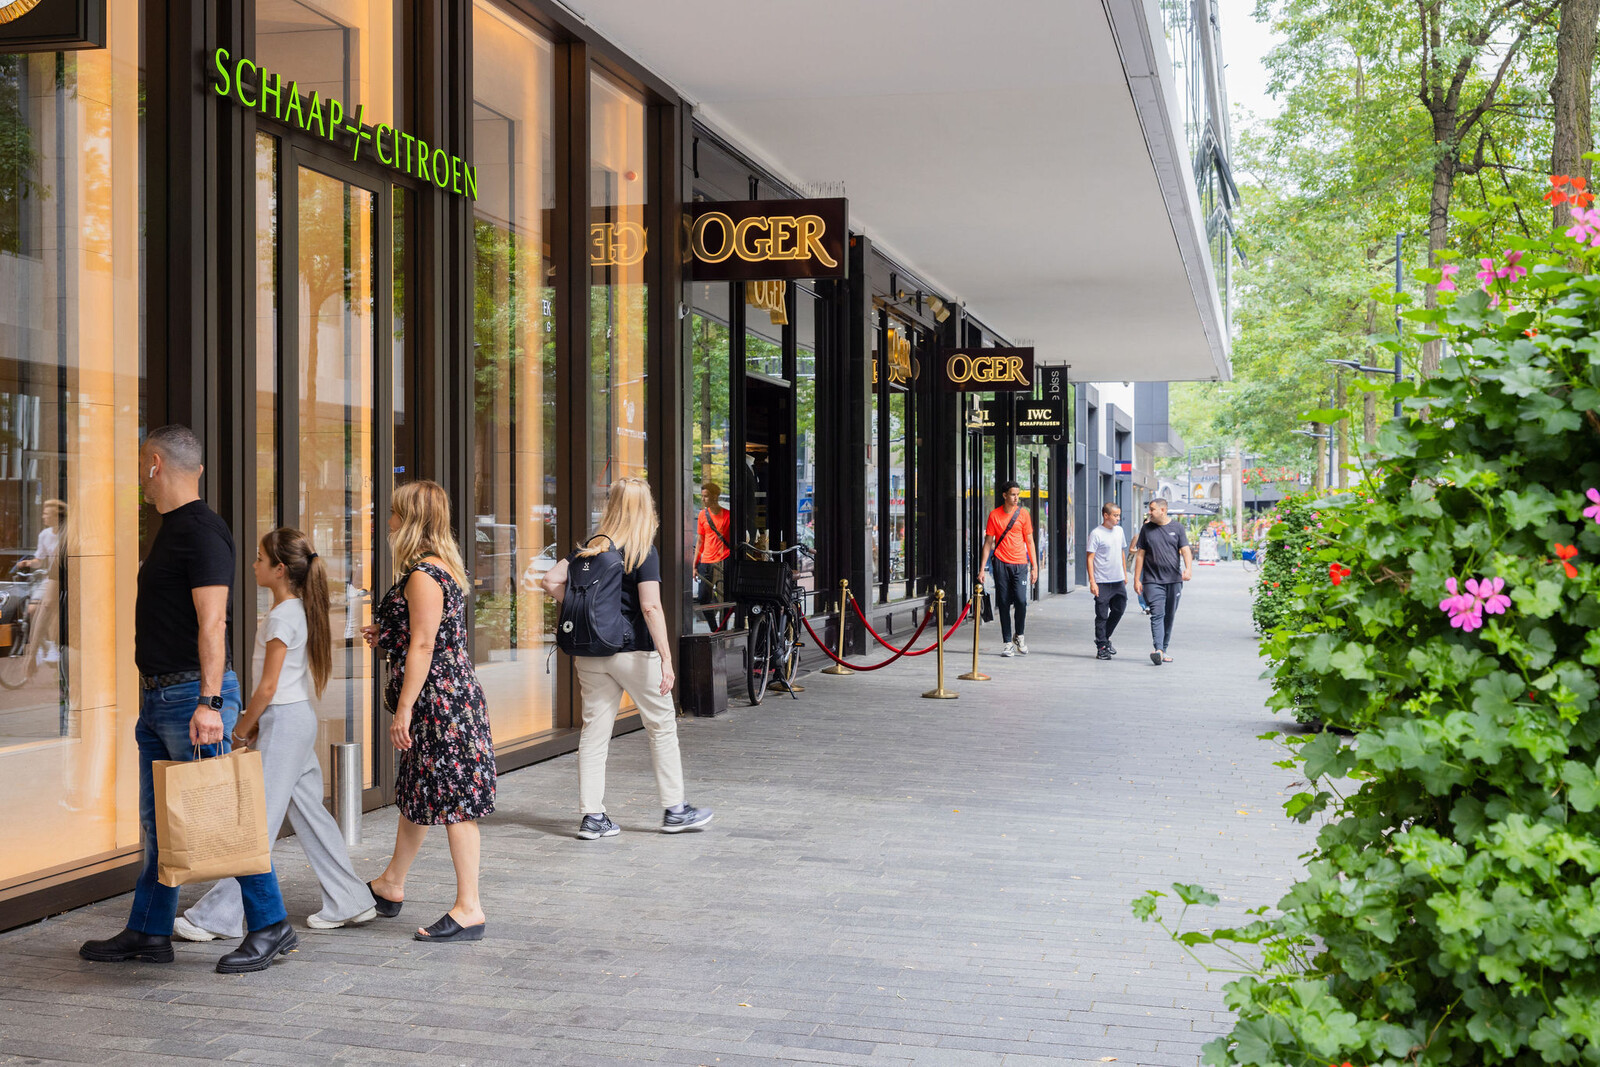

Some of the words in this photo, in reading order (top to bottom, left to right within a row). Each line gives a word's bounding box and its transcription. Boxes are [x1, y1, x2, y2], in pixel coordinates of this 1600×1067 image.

[215, 48, 343, 141] SCHAAP
[376, 123, 478, 201] CITROEN
[692, 211, 838, 268] OGER
[946, 353, 1030, 386] OGER
[1027, 408, 1052, 420] IWC
